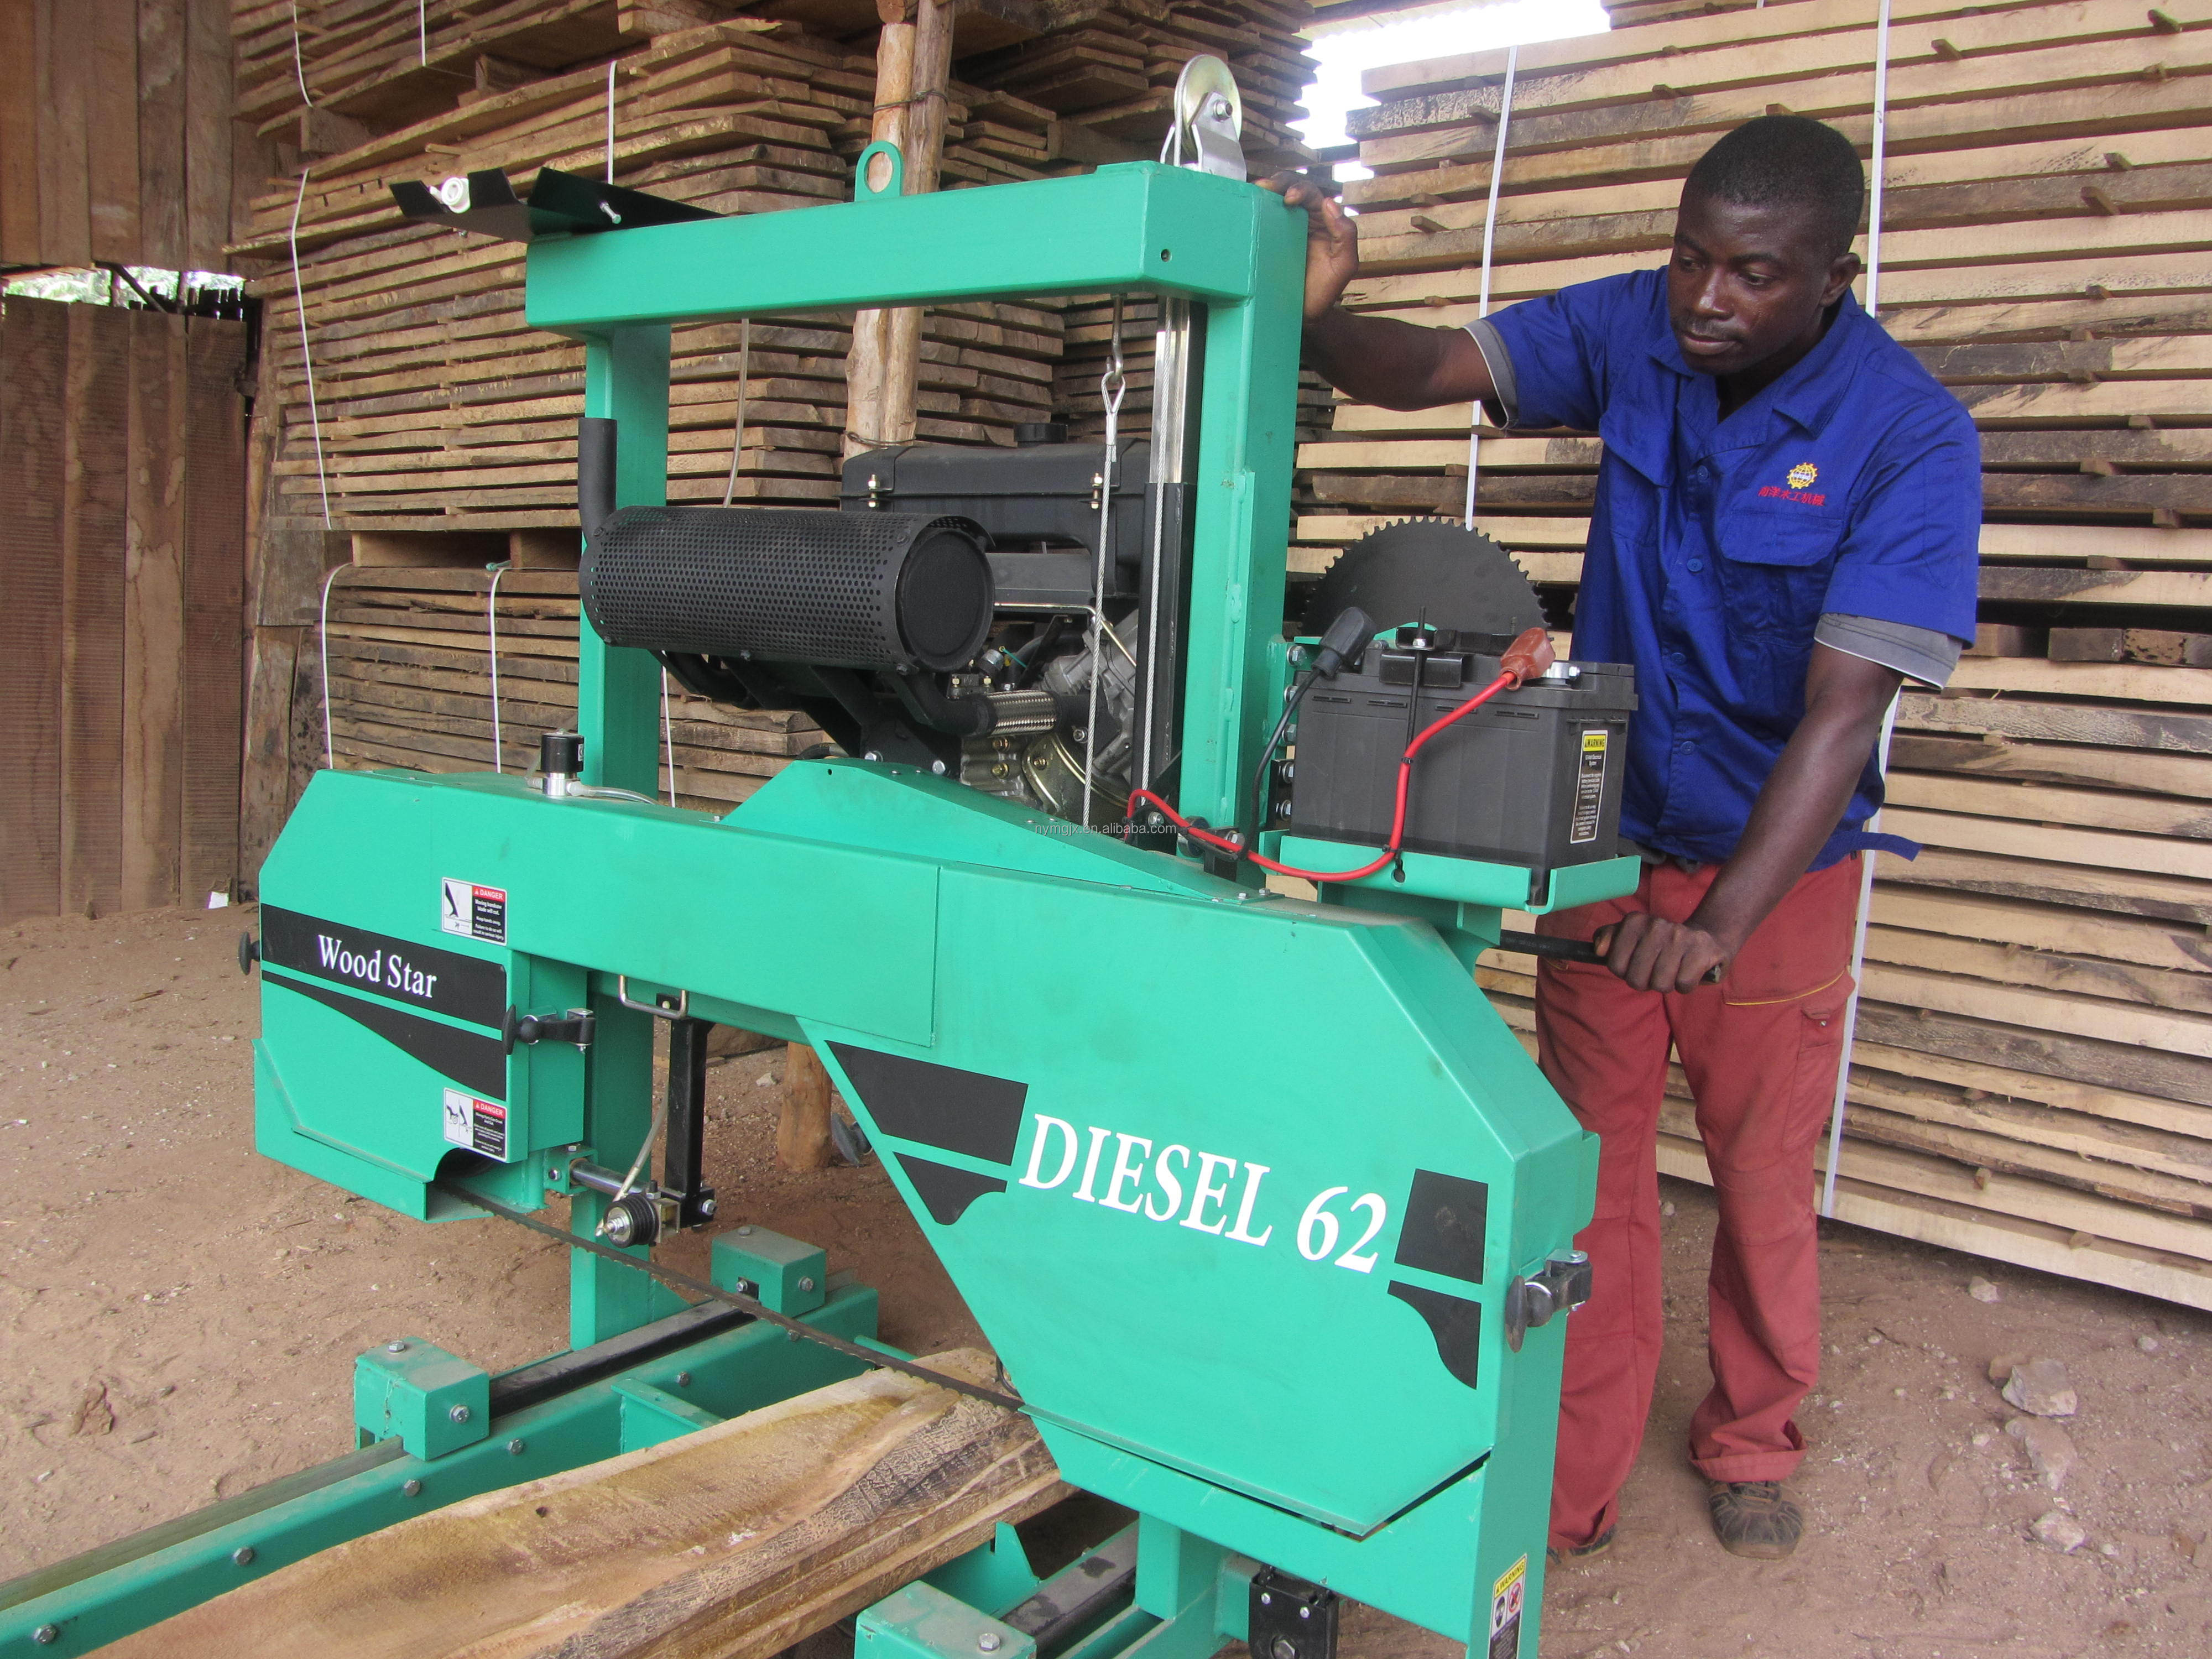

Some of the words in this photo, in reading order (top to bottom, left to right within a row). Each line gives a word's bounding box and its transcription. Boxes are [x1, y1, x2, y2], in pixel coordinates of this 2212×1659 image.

[1587, 738, 1605, 748] WARNING
[479, 889, 503, 900] DANGER
[317, 935, 382, 983] Wood
[387, 954, 437, 998] Star
[480, 1103, 503, 1117] DANGER
[1018, 1113, 1273, 1247] DIESEL
[1297, 1186, 1387, 1274] 62
[1500, 1561, 1525, 1589] WARNING
